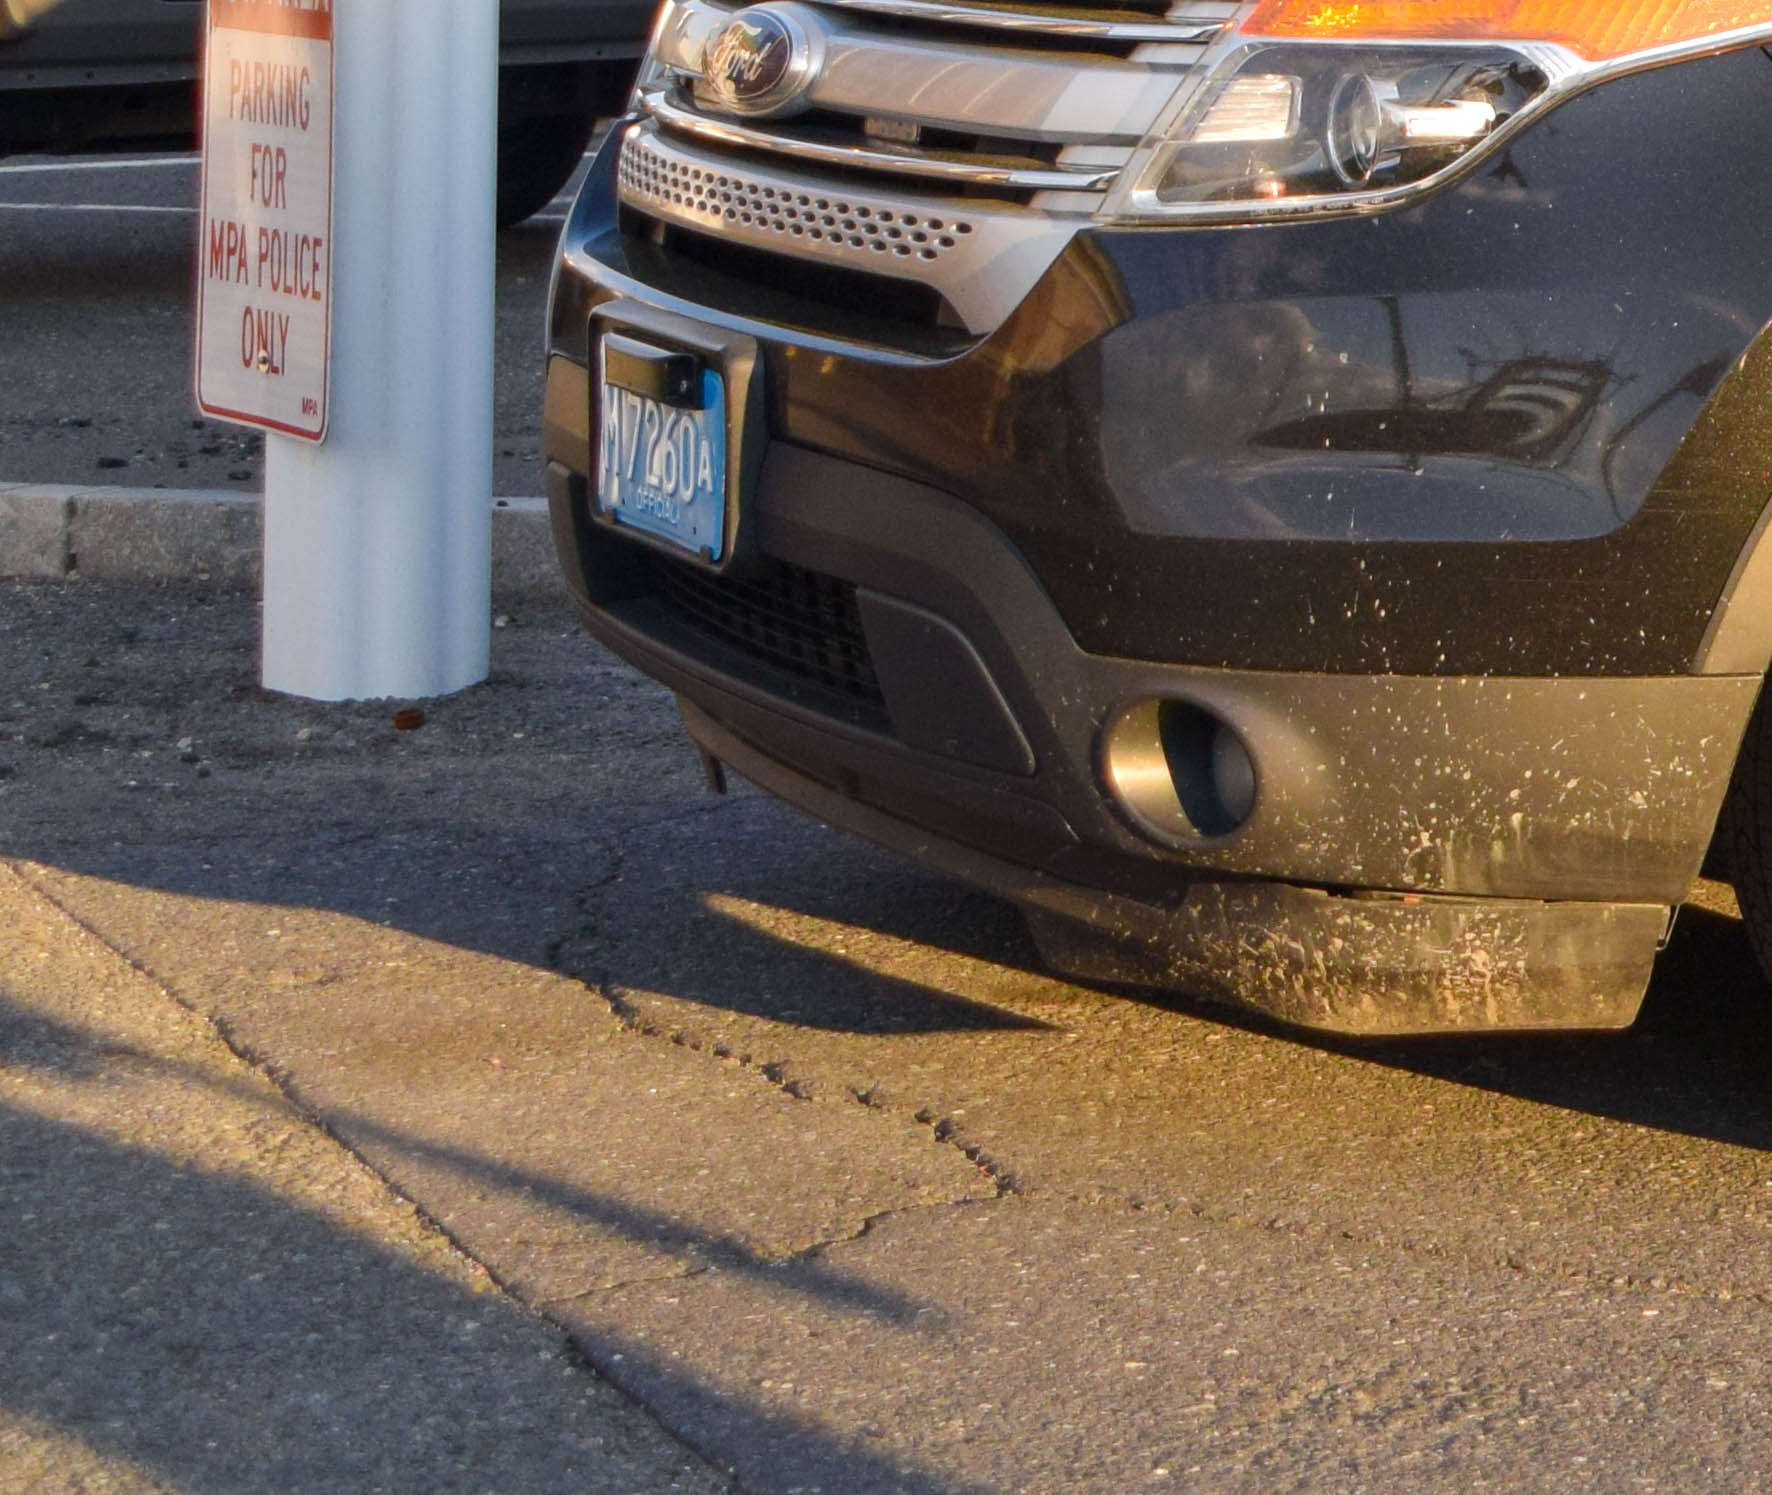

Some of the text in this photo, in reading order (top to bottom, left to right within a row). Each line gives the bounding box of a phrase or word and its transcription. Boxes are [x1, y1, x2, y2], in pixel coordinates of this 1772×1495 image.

[712, 20, 772, 82] Ford
[229, 58, 310, 132] PARKING
[250, 143, 288, 210] FOR
[209, 218, 323, 302] MPA POLICE
[241, 305, 290, 377] ONLY
[301, 396, 320, 418] MPA
